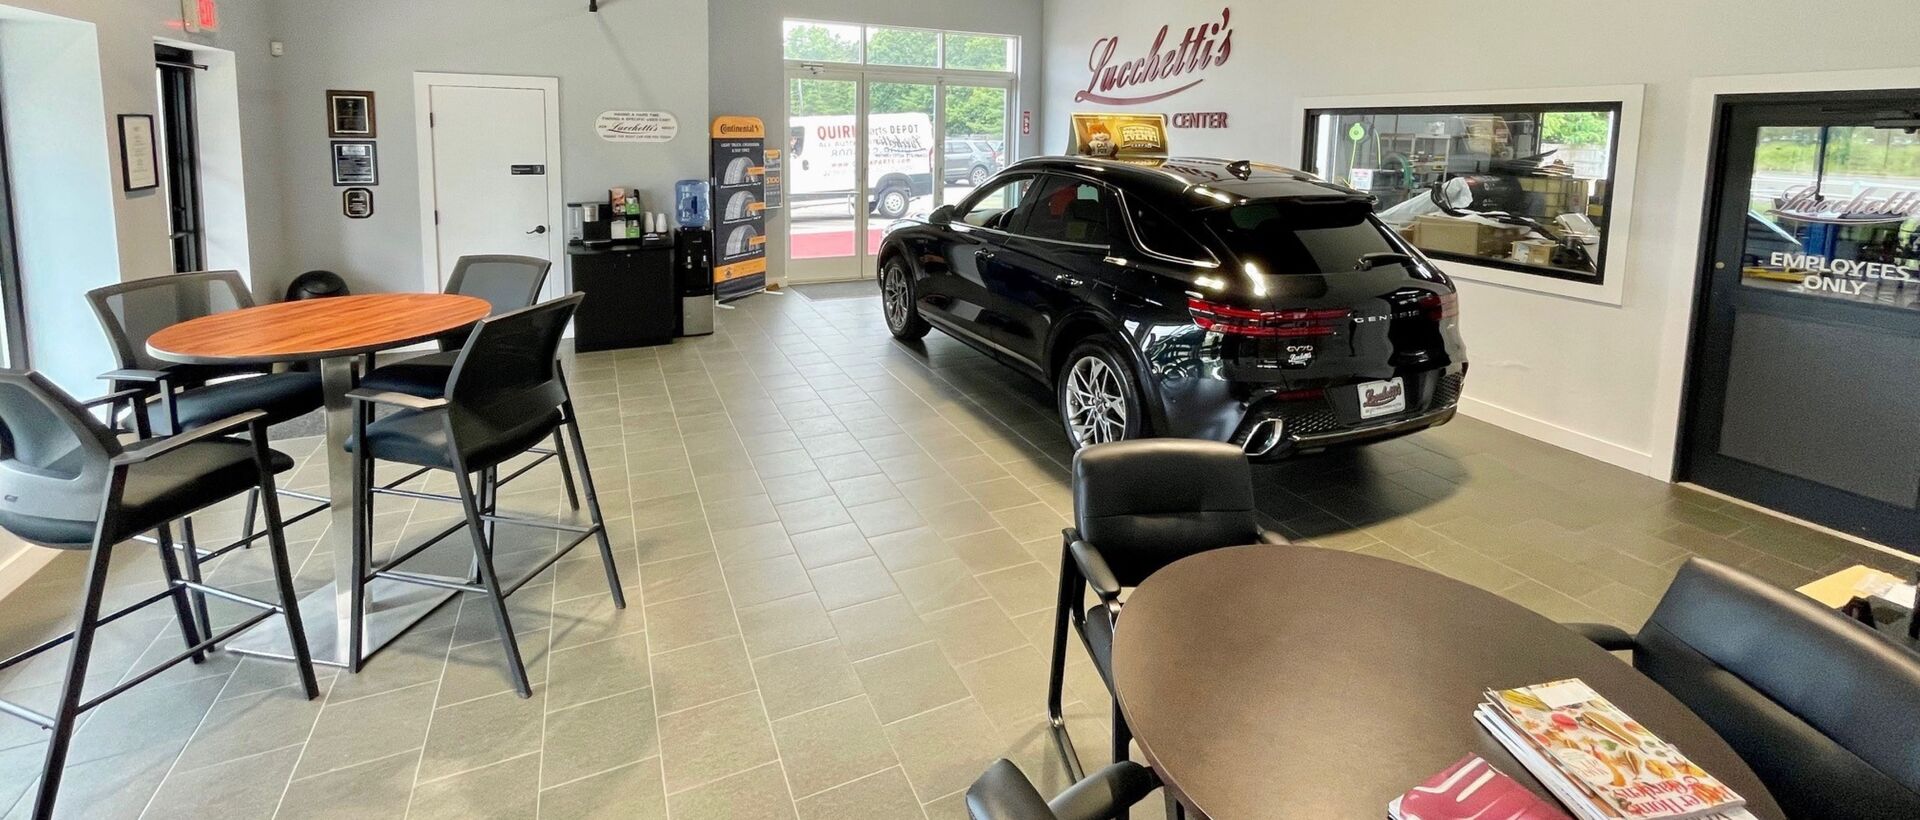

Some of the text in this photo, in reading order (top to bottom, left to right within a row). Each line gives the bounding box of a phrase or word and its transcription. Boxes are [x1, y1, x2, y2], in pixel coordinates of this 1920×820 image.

[1075, 7, 1233, 105] Lucchetti's
[607, 122, 657, 134] Lucchetti's
[720, 124, 755, 134] Continental
[1172, 112, 1229, 129] CENTER
[817, 125, 856, 140] QUIR
[889, 124, 919, 134] DEPOT
[1770, 251, 1910, 281] EMPLOYEES
[1804, 275, 1868, 295] ONLY
